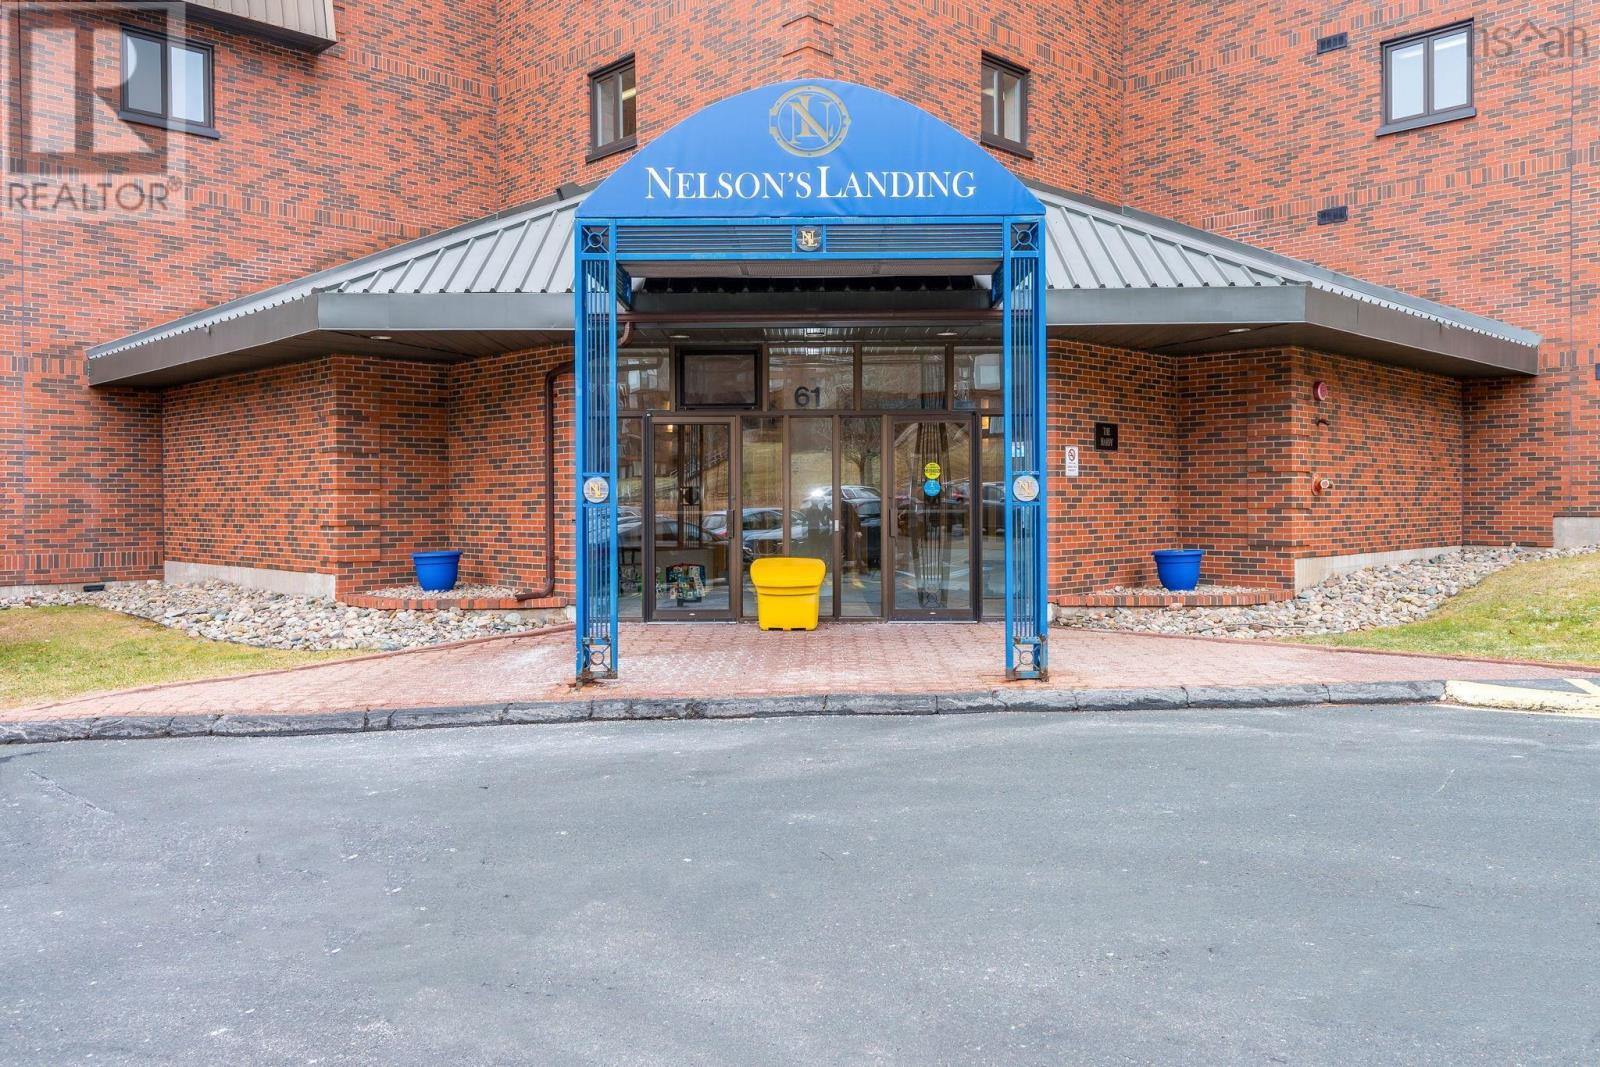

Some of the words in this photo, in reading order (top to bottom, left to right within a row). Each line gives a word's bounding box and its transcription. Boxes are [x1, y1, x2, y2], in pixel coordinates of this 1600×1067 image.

[645, 166, 812, 200] NELSON'S
[816, 165, 977, 199] LANDING
[795, 386, 820, 407] 61
